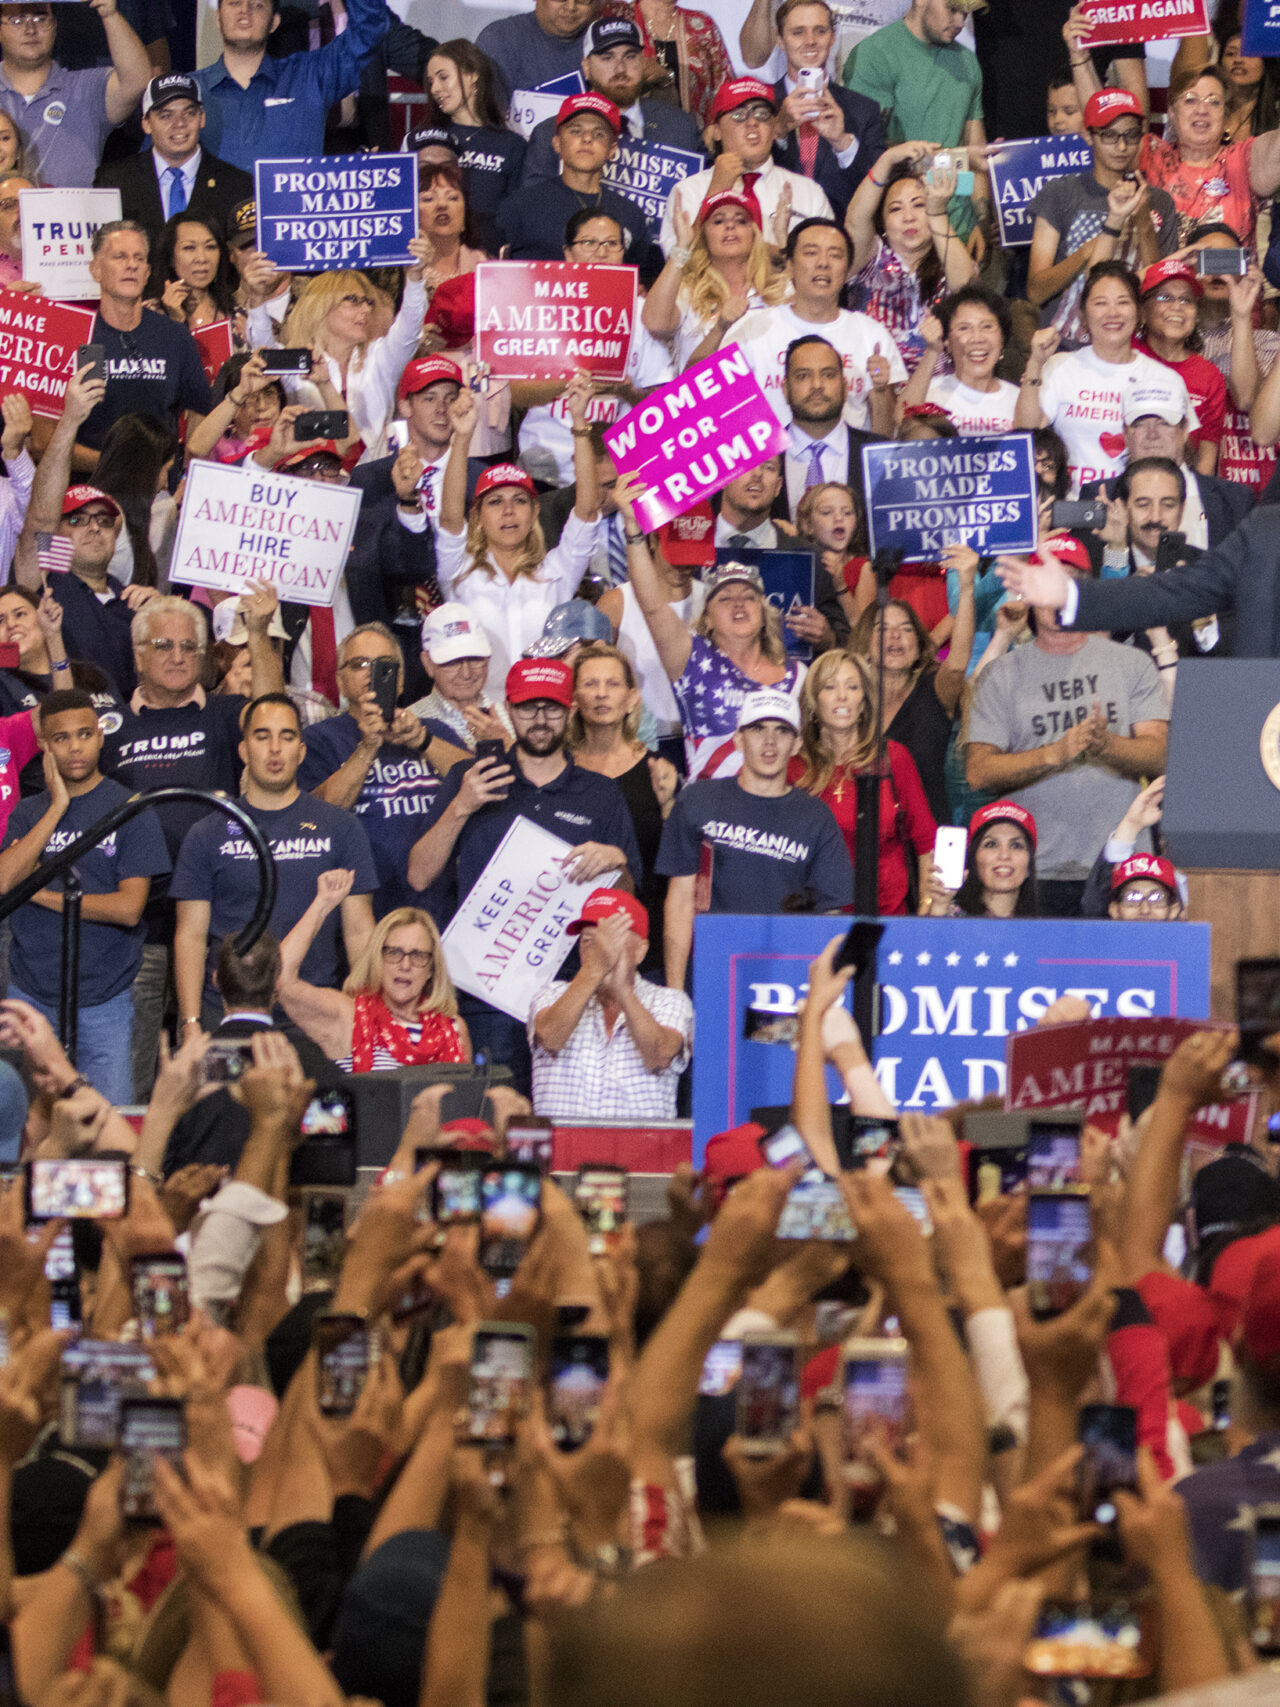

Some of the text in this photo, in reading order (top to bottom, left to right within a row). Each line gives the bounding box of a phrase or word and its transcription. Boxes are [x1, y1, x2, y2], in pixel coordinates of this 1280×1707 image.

[1086, 0, 1195, 24] GREAT AGAIN
[611, 147, 688, 181] OMISES
[1041, 151, 1092, 169] MAKE
[273, 168, 401, 193] PROMISES
[301, 191, 376, 213] MADE
[274, 216, 403, 241] PROMISES
[43, 244, 85, 256] PEN
[304, 239, 372, 261] KEPT
[534, 281, 590, 299] MAKE
[0, 307, 46, 333] MAKE
[480, 305, 631, 335] AMERICA
[0, 331, 78, 376] ERICA
[493, 338, 622, 359] GREAT AGAIN
[110, 359, 167, 374] LAXALT
[13, 368, 67, 398] AGAIN
[1078, 390, 1120, 402] CHIN
[608, 351, 752, 459] WOMEN
[1066, 405, 1122, 421] AMERI
[661, 416, 719, 459] FOR
[637, 421, 772, 517] TRUMP
[883, 450, 1017, 480] PROMISES
[250, 484, 298, 508] BUY
[914, 474, 992, 500] MADE
[193, 498, 343, 543] AMERICAN
[888, 501, 1021, 531] PROMISES
[239, 532, 292, 558] HIRE
[921, 525, 990, 550] KEPT
[185, 546, 332, 589] AMERICAN
[1042, 674, 1100, 703] VERY
[1032, 701, 1118, 737] STABE
[119, 731, 206, 757] TRUMP
[1122, 858, 1162, 876] USA
[473, 879, 514, 932] KEEP
[526, 900, 575, 967] GREAT
[1090, 1035, 1174, 1053] MAKE
[835, 1056, 1007, 1107] MAD
